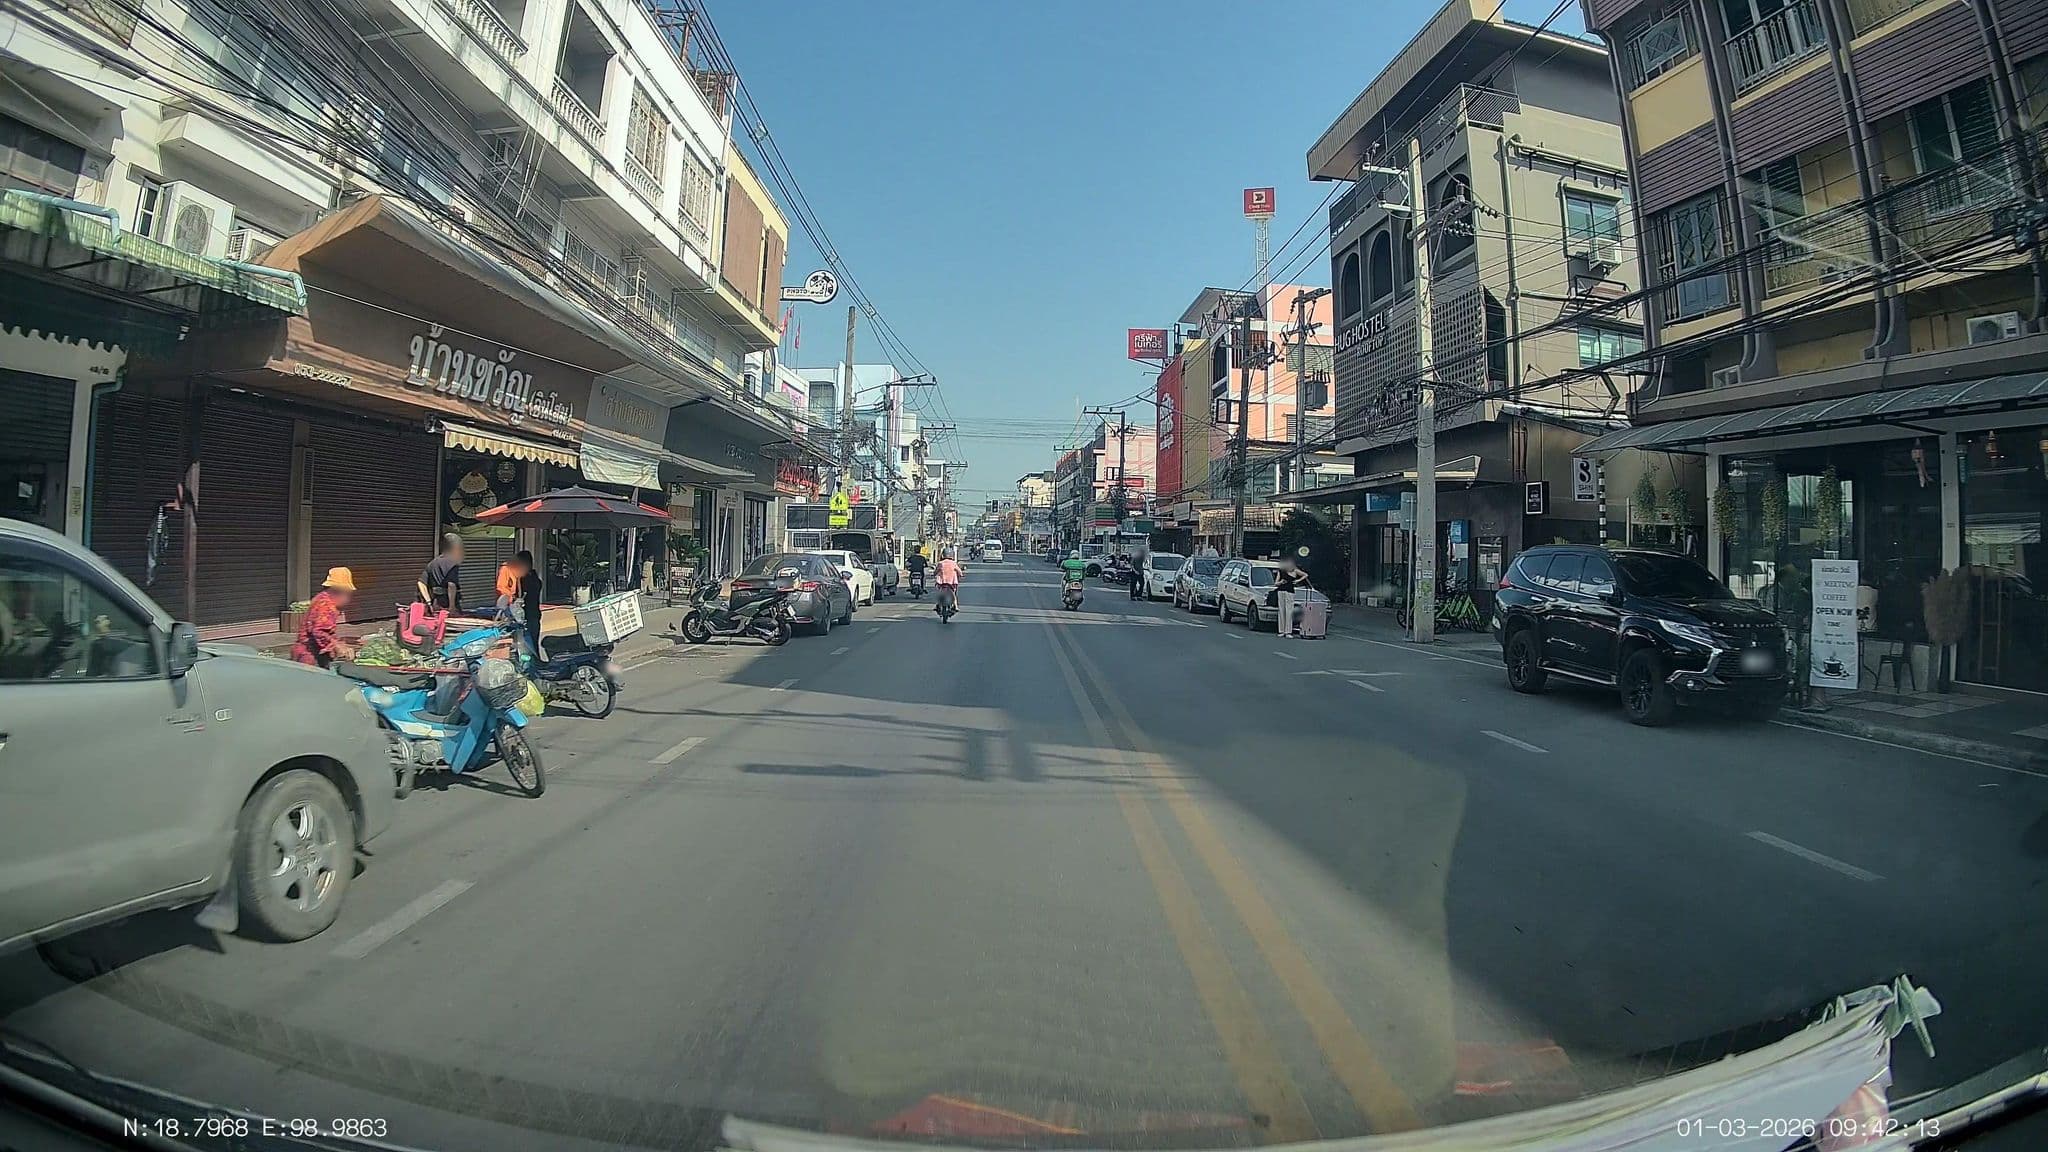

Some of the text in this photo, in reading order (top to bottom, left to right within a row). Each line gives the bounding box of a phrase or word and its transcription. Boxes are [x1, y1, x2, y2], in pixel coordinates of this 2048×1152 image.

[404, 324, 532, 425] บ้านขวัญ
[1816, 606, 1854, 616] OPEN NOW
